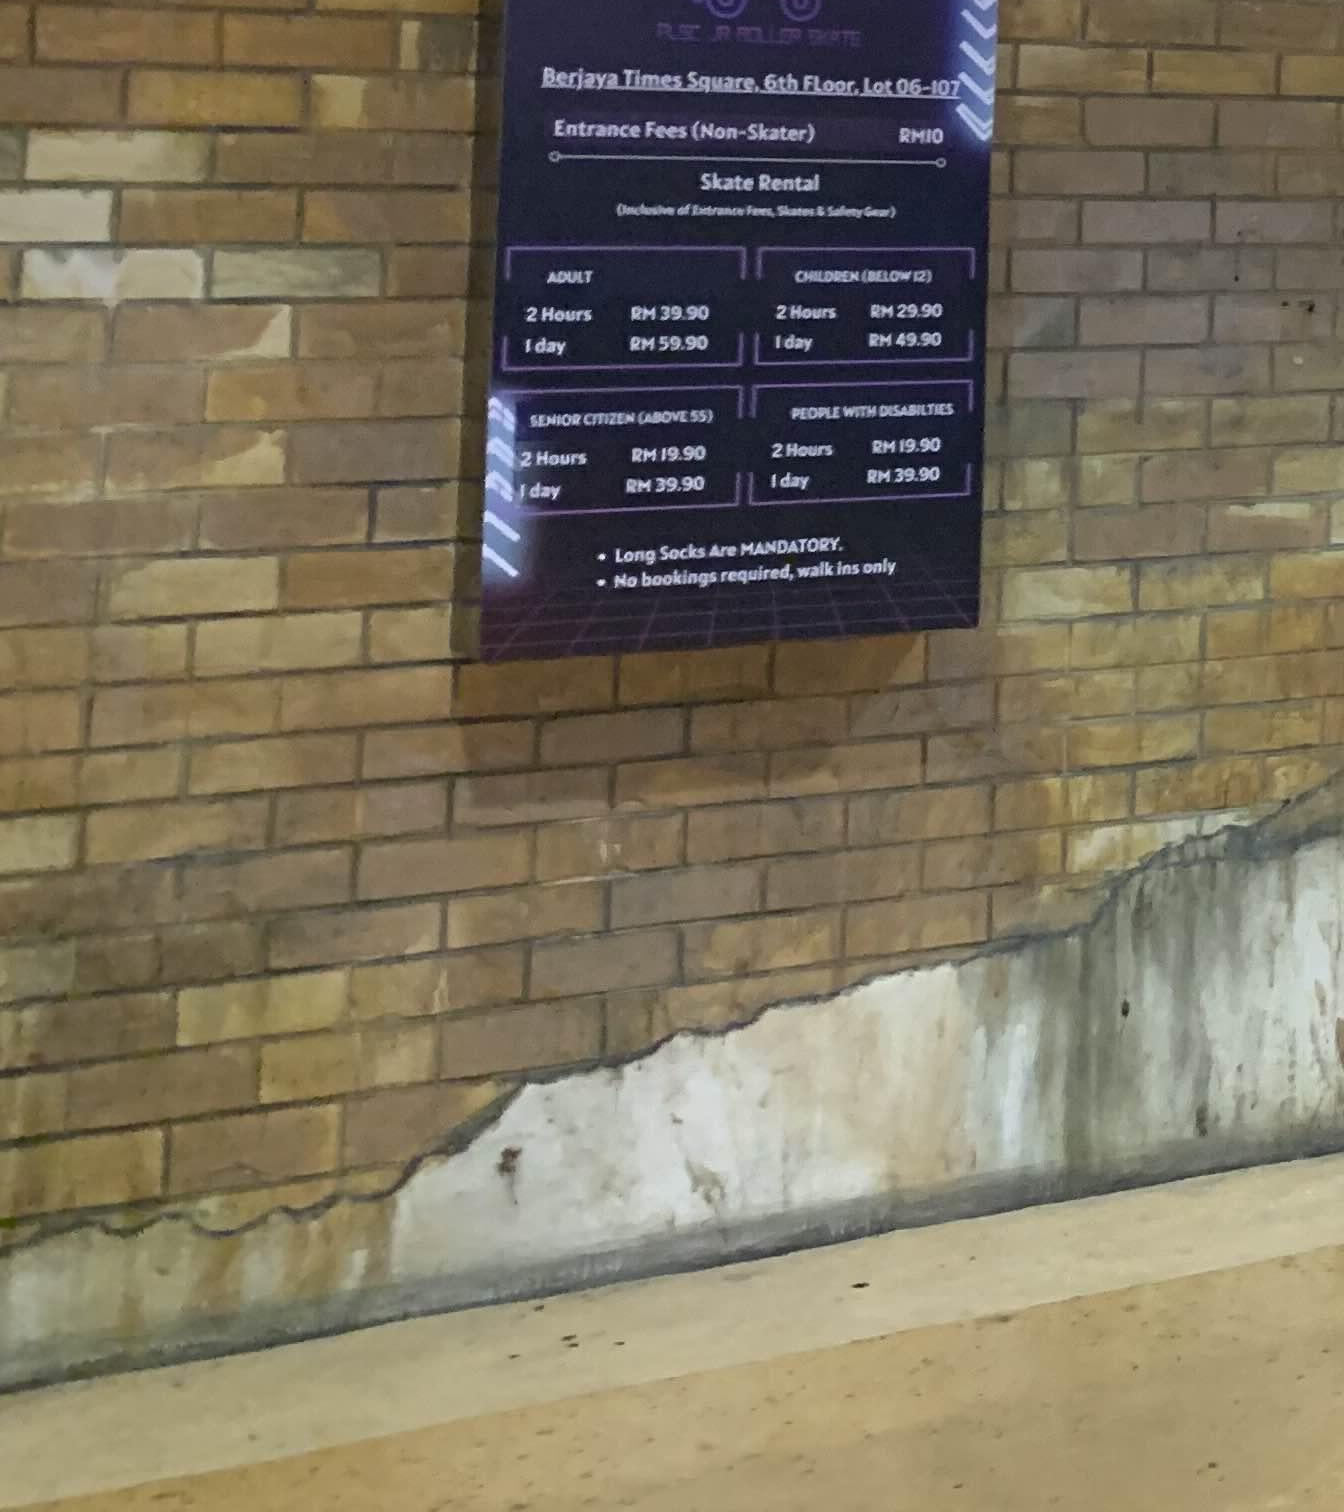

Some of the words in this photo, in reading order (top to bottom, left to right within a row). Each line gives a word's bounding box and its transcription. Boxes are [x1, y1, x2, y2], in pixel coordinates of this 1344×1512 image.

[541, 66, 618, 92] Berjaya
[623, 69, 682, 90] Times
[688, 72, 760, 94] Square,
[764, 74, 798, 92] 6th
[895, 78, 961, 97] 06-107
[554, 119, 640, 139] Entrance
[645, 121, 686, 139] Fees
[691, 122, 815, 144] (Non-Skater)
[898, 128, 944, 144] RM10
[701, 173, 754, 191] Skate
[759, 173, 820, 192] Rental
[547, 270, 593, 285] ADULT
[794, 270, 859, 284] CHILDREN
[862, 270, 911, 285] (BELOW
[913, 269, 932, 285] 12)
[526, 307, 537, 321] 2
[542, 307, 592, 322] Hours
[631, 306, 656, 321] RM
[659, 305, 710, 321] 39.90
[776, 305, 787, 319] 2
[789, 305, 837, 320] Hours
[870, 304, 895, 318] RM
[897, 303, 943, 318] 29.90
[536, 337, 567, 357] day
[629, 337, 655, 351] RM
[658, 335, 709, 352] 59.90
[784, 334, 813, 353] day
[868, 334, 893, 348] RM
[896, 332, 942, 348] 49.90
[530, 413, 581, 428] SENIOR
[582, 411, 635, 426] CITIZEN
[638, 410, 687, 426] (ABOVE
[791, 405, 841, 420] PEOPLE
[843, 404, 877, 418] WITH
[520, 452, 532, 467] 2
[537, 450, 587, 467] Hours
[631, 447, 656, 462] RM
[660, 446, 706, 462] 19.90
[771, 443, 783, 458] 2
[786, 442, 833, 458] Hours
[872, 439, 897, 453] RM
[899, 438, 941, 453] 19.90
[531, 482, 561, 501] day
[626, 478, 652, 493] RM
[656, 476, 705, 492] 39.90
[780, 473, 810, 491] day
[867, 469, 892, 484] RM
[895, 467, 940, 483] 39.90
[616, 547, 656, 567] Long
[659, 544, 705, 561] Socks
[709, 543, 737, 558] Are
[740, 537, 843, 557] MANDATORY.
[614, 574, 636, 589] No
[641, 569, 716, 591] bookings
[720, 564, 794, 586] required,
[797, 561, 833, 577] walk
[836, 560, 859, 575] ins
[862, 558, 897, 578] only
